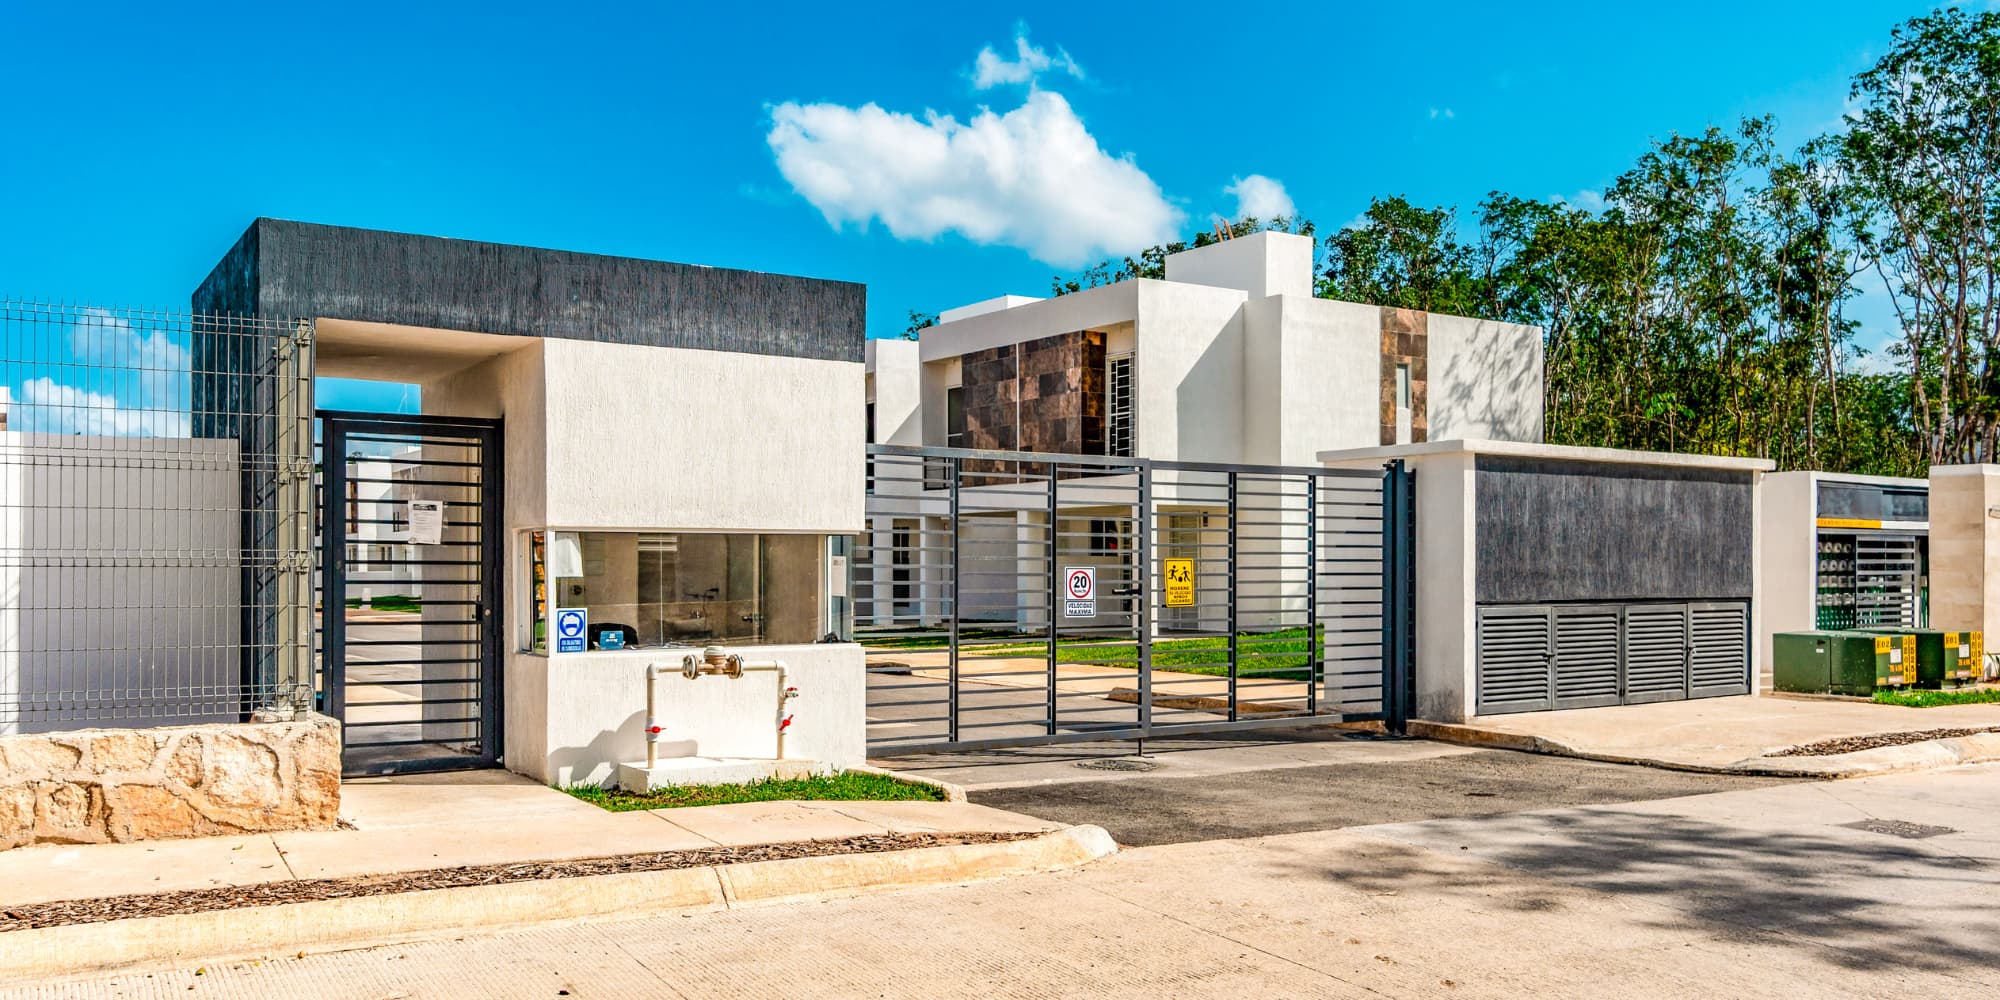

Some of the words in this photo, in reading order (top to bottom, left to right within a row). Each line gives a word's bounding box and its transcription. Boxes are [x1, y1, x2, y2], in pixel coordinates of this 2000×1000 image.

[1073, 576, 1087, 588] 20
[1876, 639, 1890, 648] E02
[1946, 635, 1957, 644] E01
